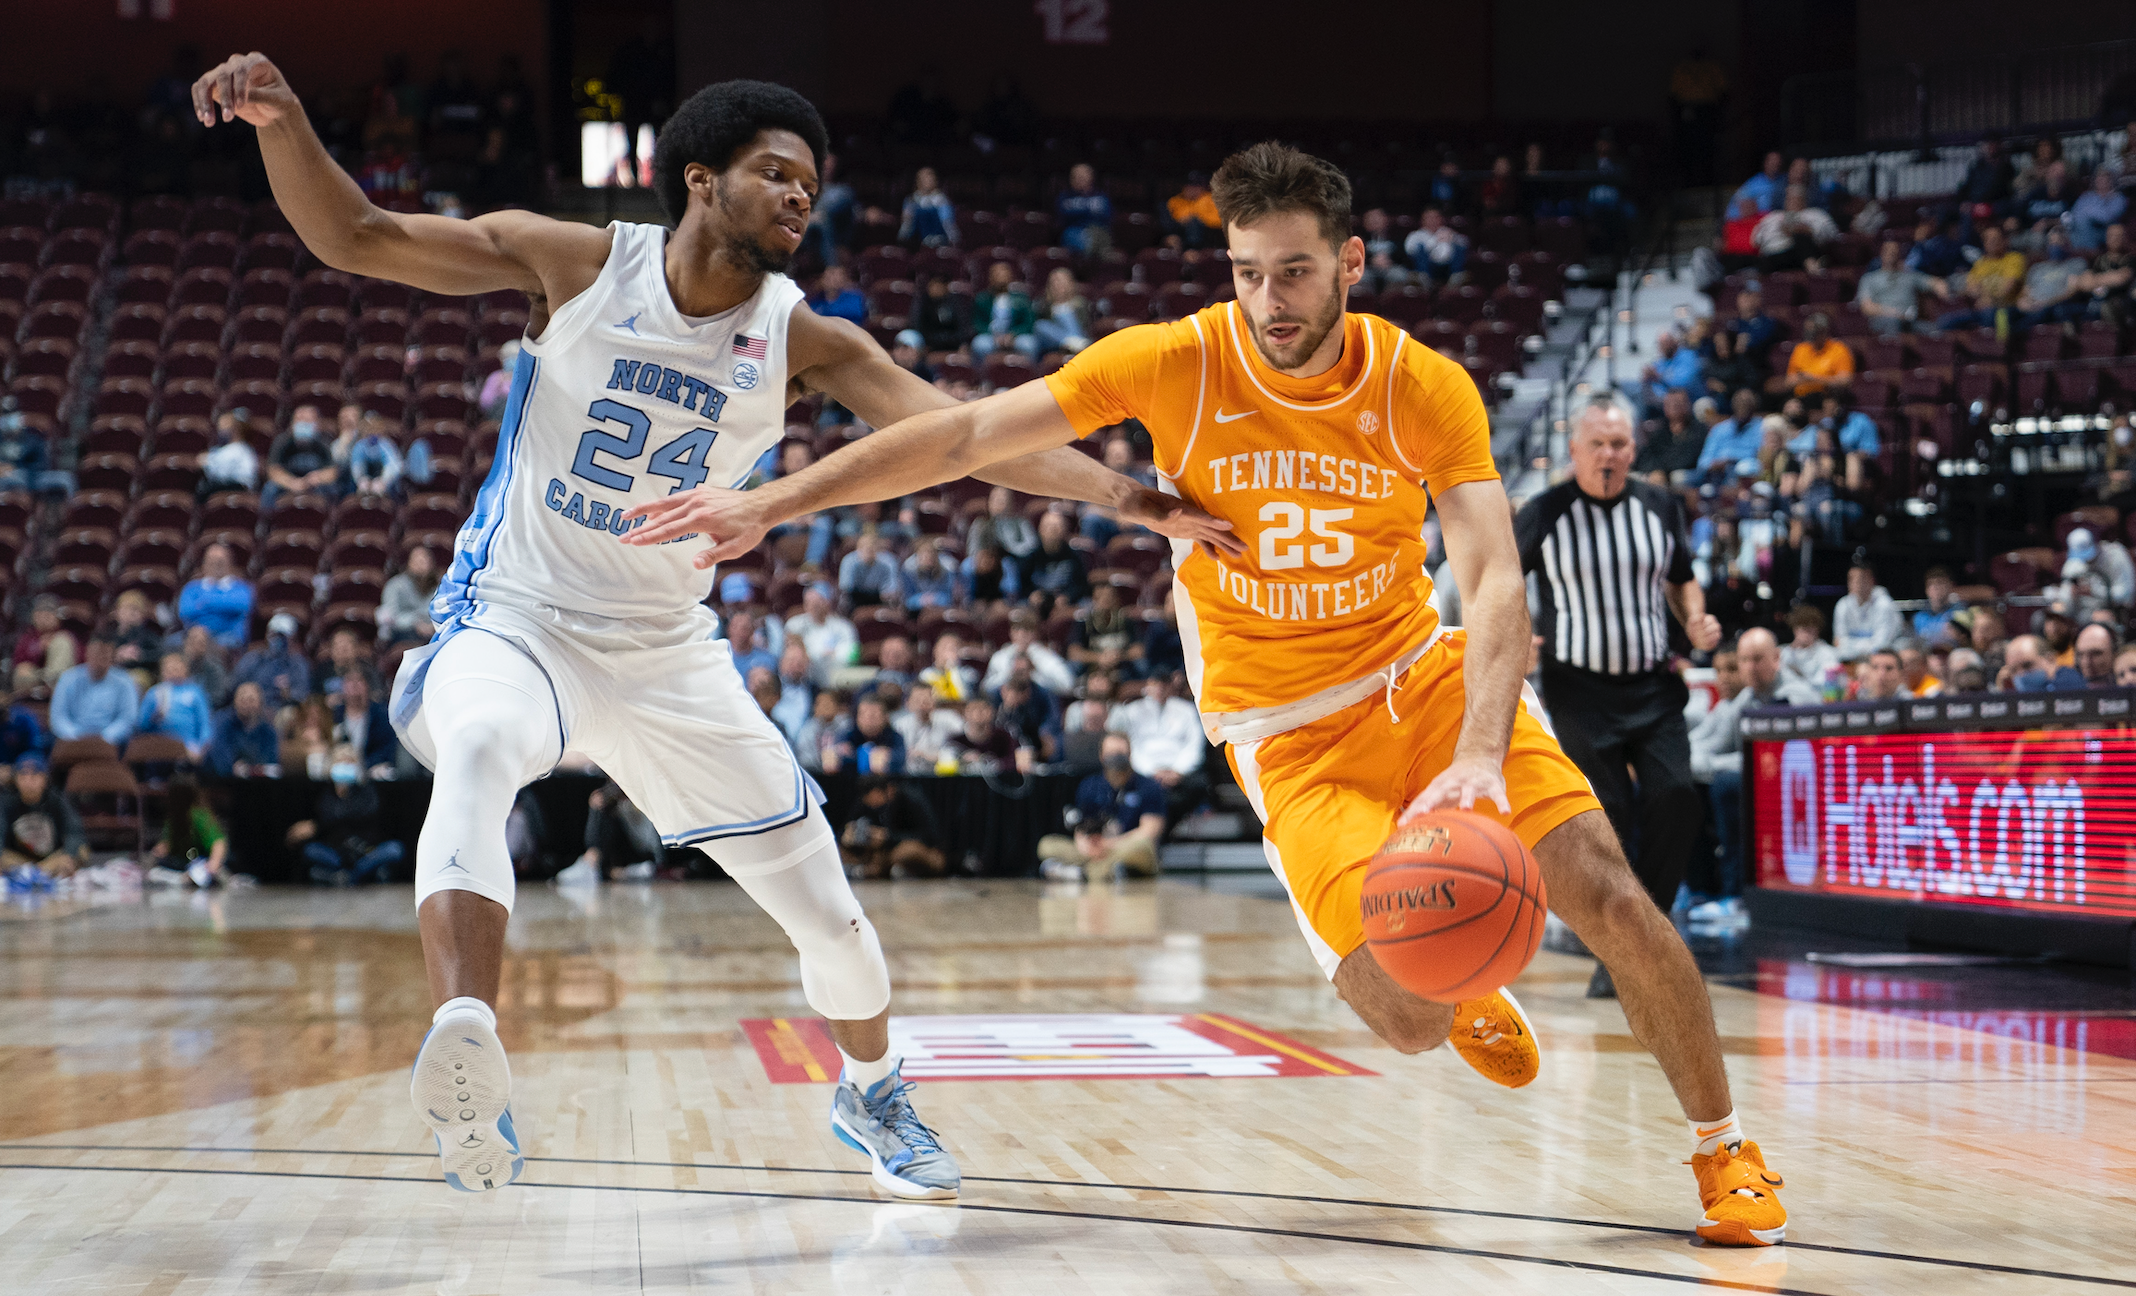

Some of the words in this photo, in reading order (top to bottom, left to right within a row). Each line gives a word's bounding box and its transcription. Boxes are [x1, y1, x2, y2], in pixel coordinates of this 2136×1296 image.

[606, 359, 728, 423] NORTH
[1359, 412, 1377, 433] SEC
[571, 398, 719, 496] 24
[1208, 450, 1397, 499] TENNESSEE
[544, 477, 699, 545] CARO
[1259, 501, 1354, 570] 25
[1216, 548, 1400, 621] VOLUNTEERS
[1824, 742, 2086, 904] Hotels.com
